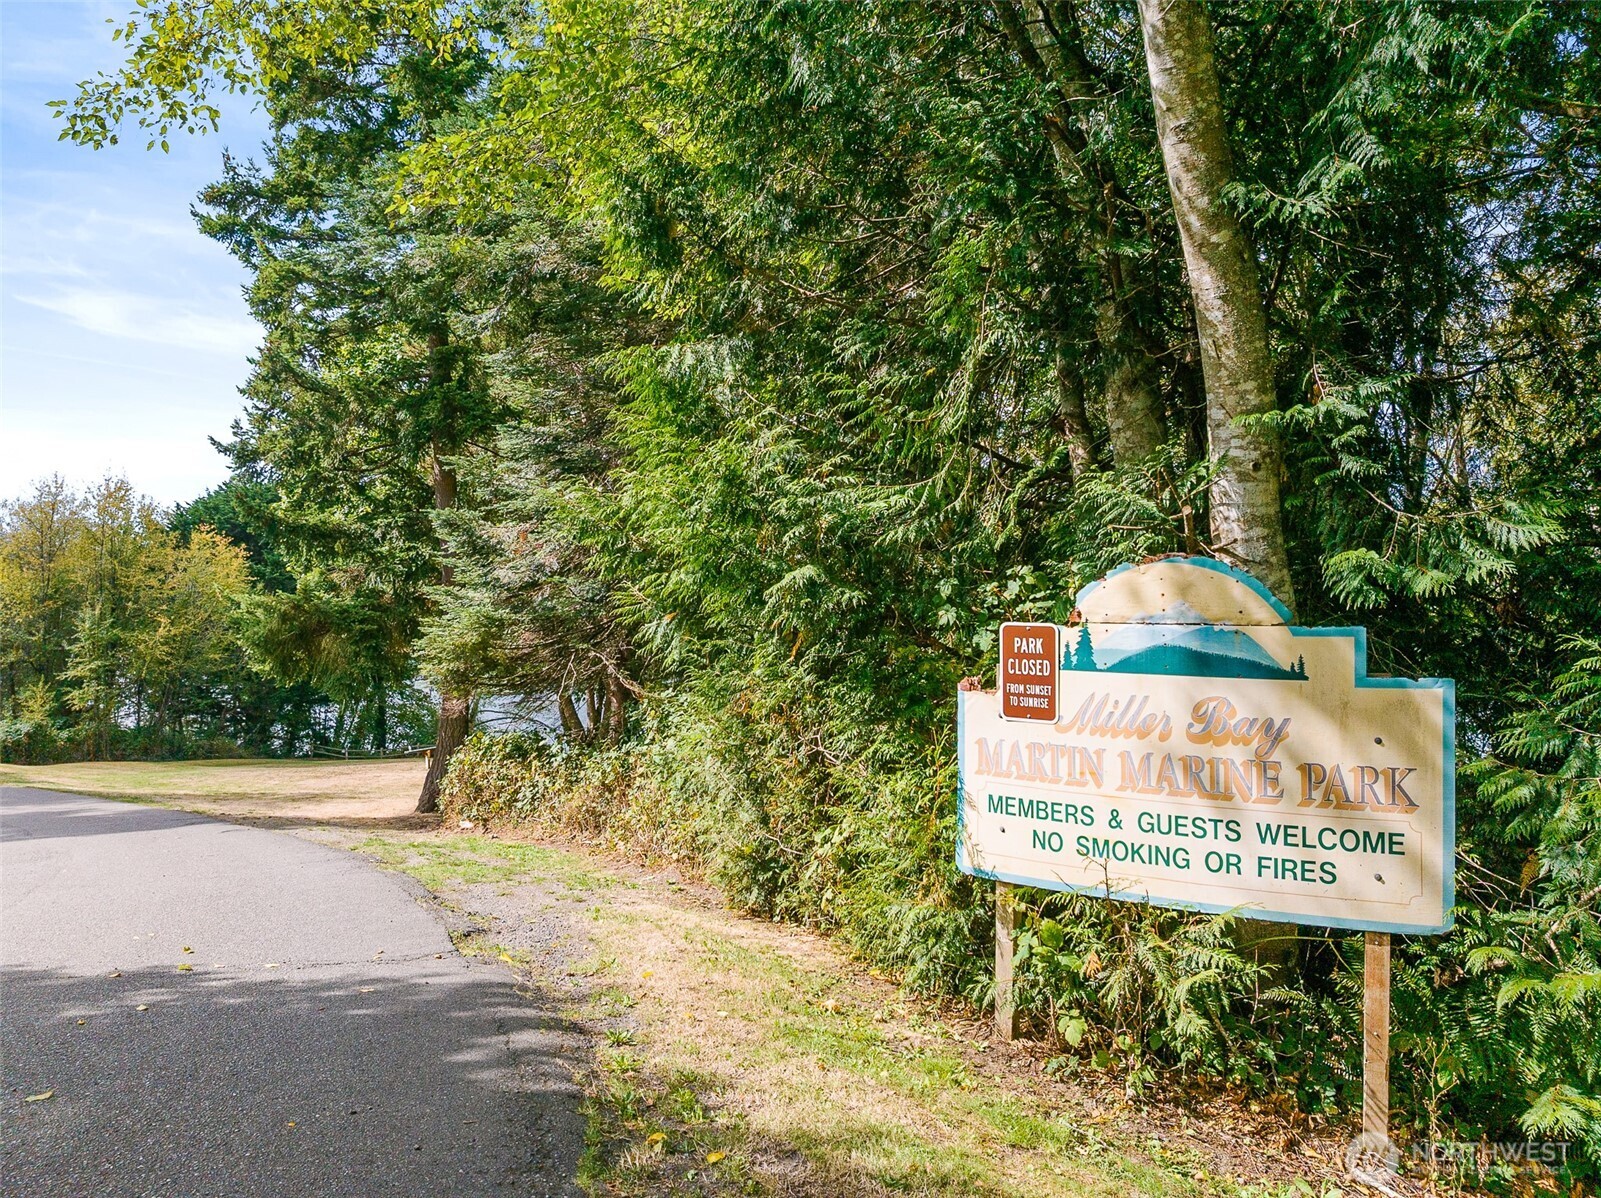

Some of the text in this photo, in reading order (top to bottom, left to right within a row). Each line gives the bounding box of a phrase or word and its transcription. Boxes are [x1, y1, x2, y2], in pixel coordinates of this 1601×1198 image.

[1014, 637, 1043, 655] PARK
[1007, 658, 1051, 676] CLOSED
[1006, 683, 1052, 696] FROM SUNSET
[1009, 695, 1049, 709] TO SUNRISE
[1056, 692, 1292, 760] Miller Bay
[974, 736, 1420, 815] MARTIN MARINE PARK
[987, 794, 1406, 856] MEMBERS & GUESTS WELCOME
[1032, 829, 1338, 885] NO SMOKING OR FIRES
